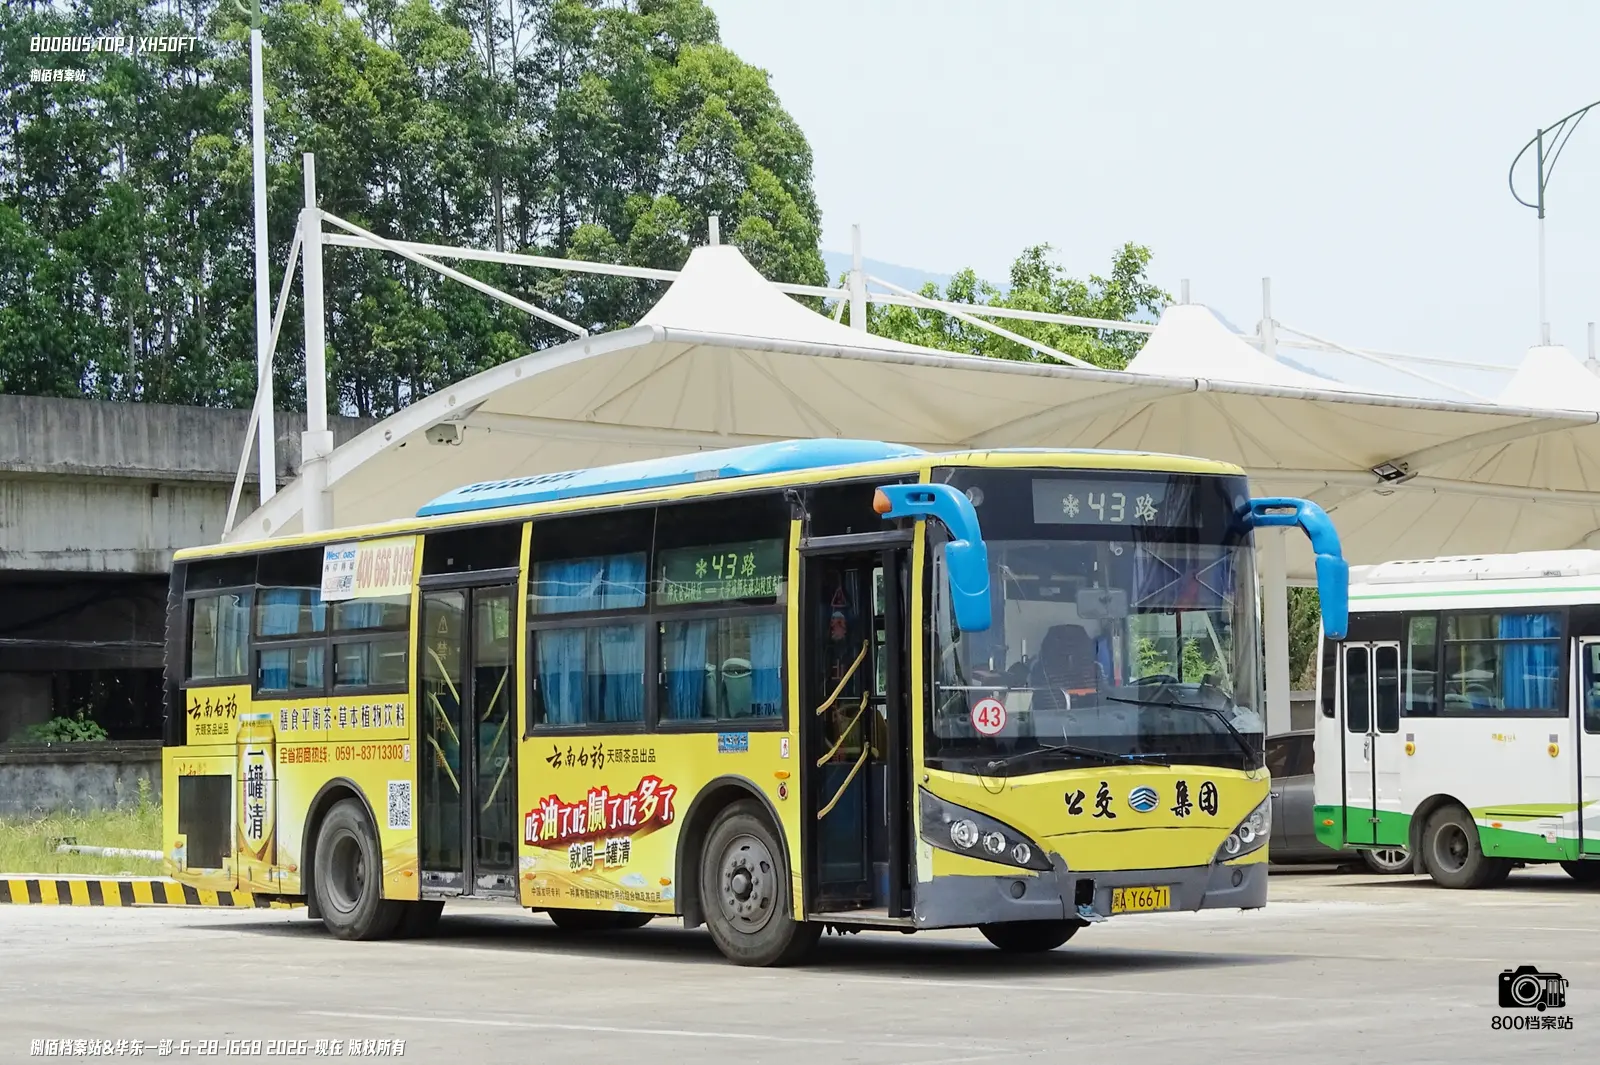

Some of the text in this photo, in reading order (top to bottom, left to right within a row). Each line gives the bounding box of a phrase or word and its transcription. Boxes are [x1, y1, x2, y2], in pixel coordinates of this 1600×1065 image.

[1088, 492, 1159, 522] 43 路
[356, 549, 374, 589] 400
[374, 547, 391, 588] 666
[711, 551, 757, 580] 43 路
[187, 693, 238, 720] 云南白药
[978, 706, 1001, 728] 43
[195, 722, 229, 736] 天颐茶品出品
[335, 743, 403, 761] 0591-83713303
[546, 742, 656, 770] 云南白药 天颐茶品出品
[247, 749, 265, 840] 一罐清
[1065, 780, 1218, 819] 公交 集团
[569, 838, 631, 870] 就喝一罐清
